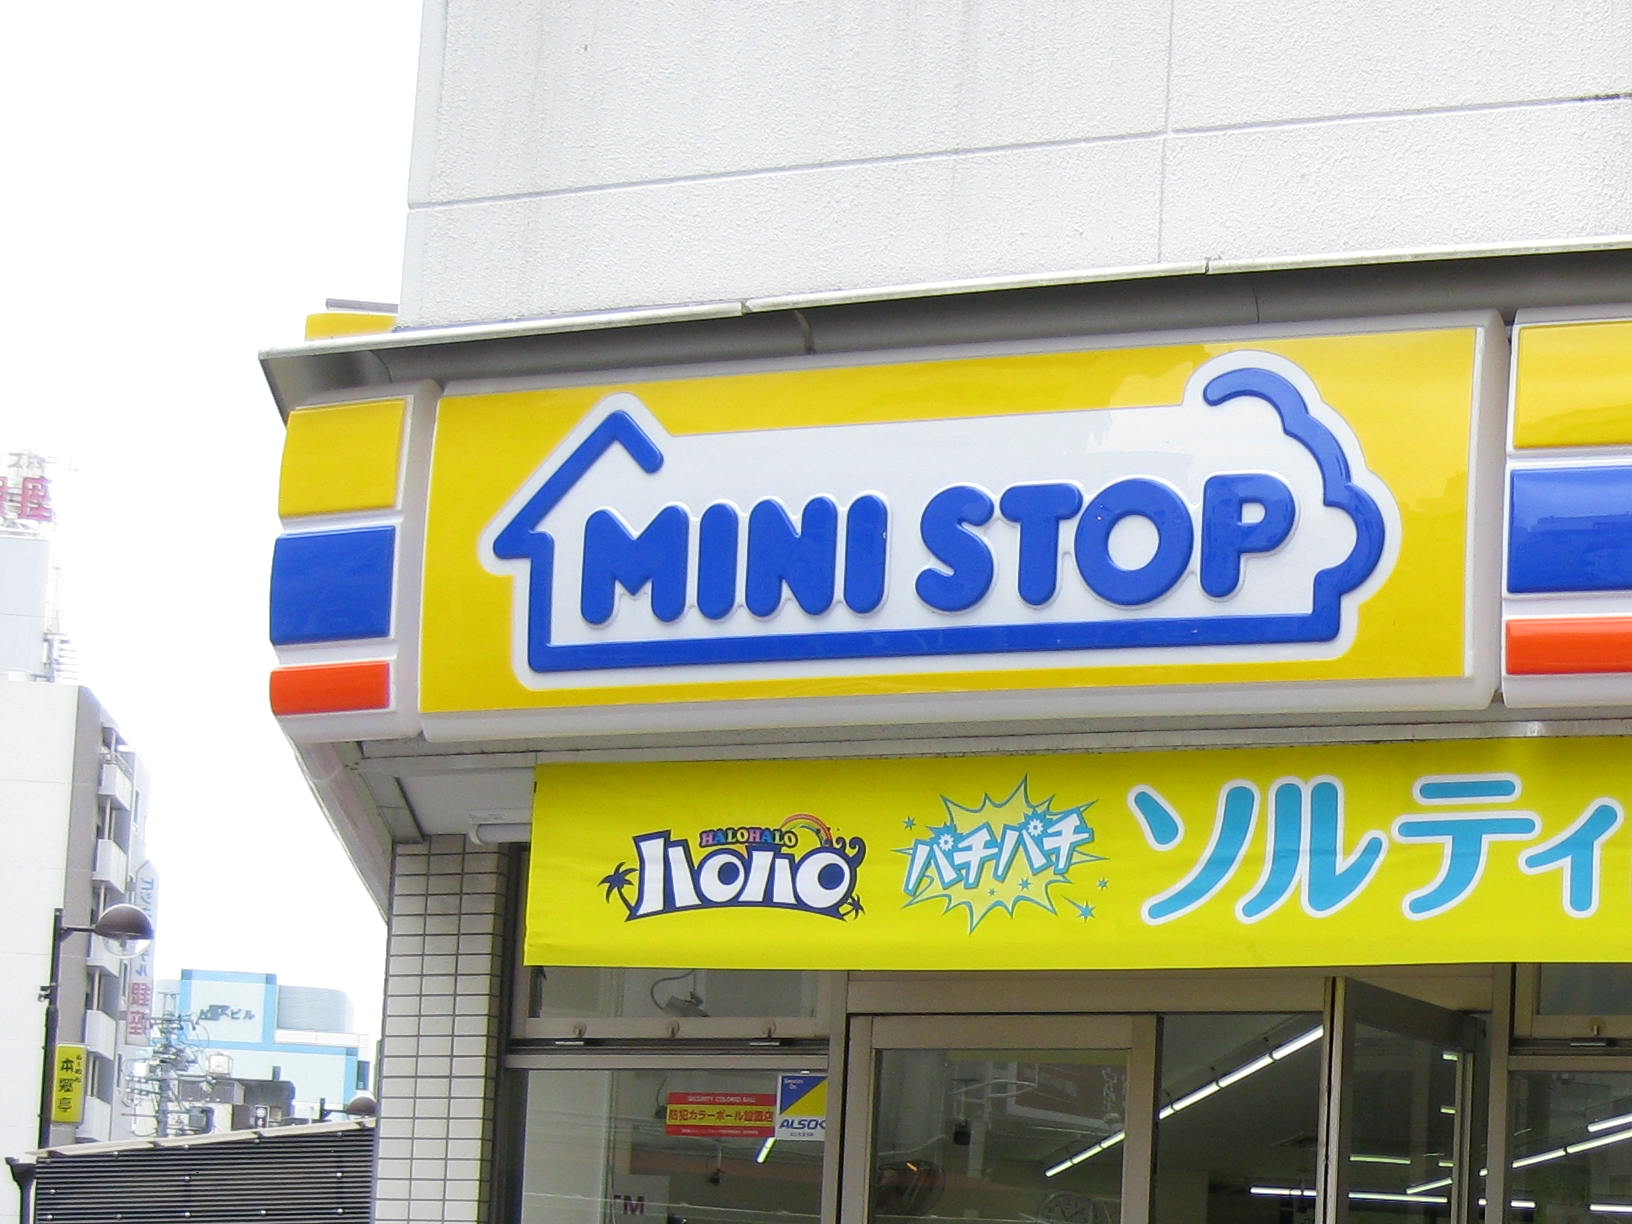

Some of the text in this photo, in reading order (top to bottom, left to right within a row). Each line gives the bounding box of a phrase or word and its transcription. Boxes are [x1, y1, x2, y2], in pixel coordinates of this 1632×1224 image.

[581, 473, 1296, 624] MINI STOP
[700, 827, 799, 848] HALOHALO
[905, 812, 1095, 897] パチパチ
